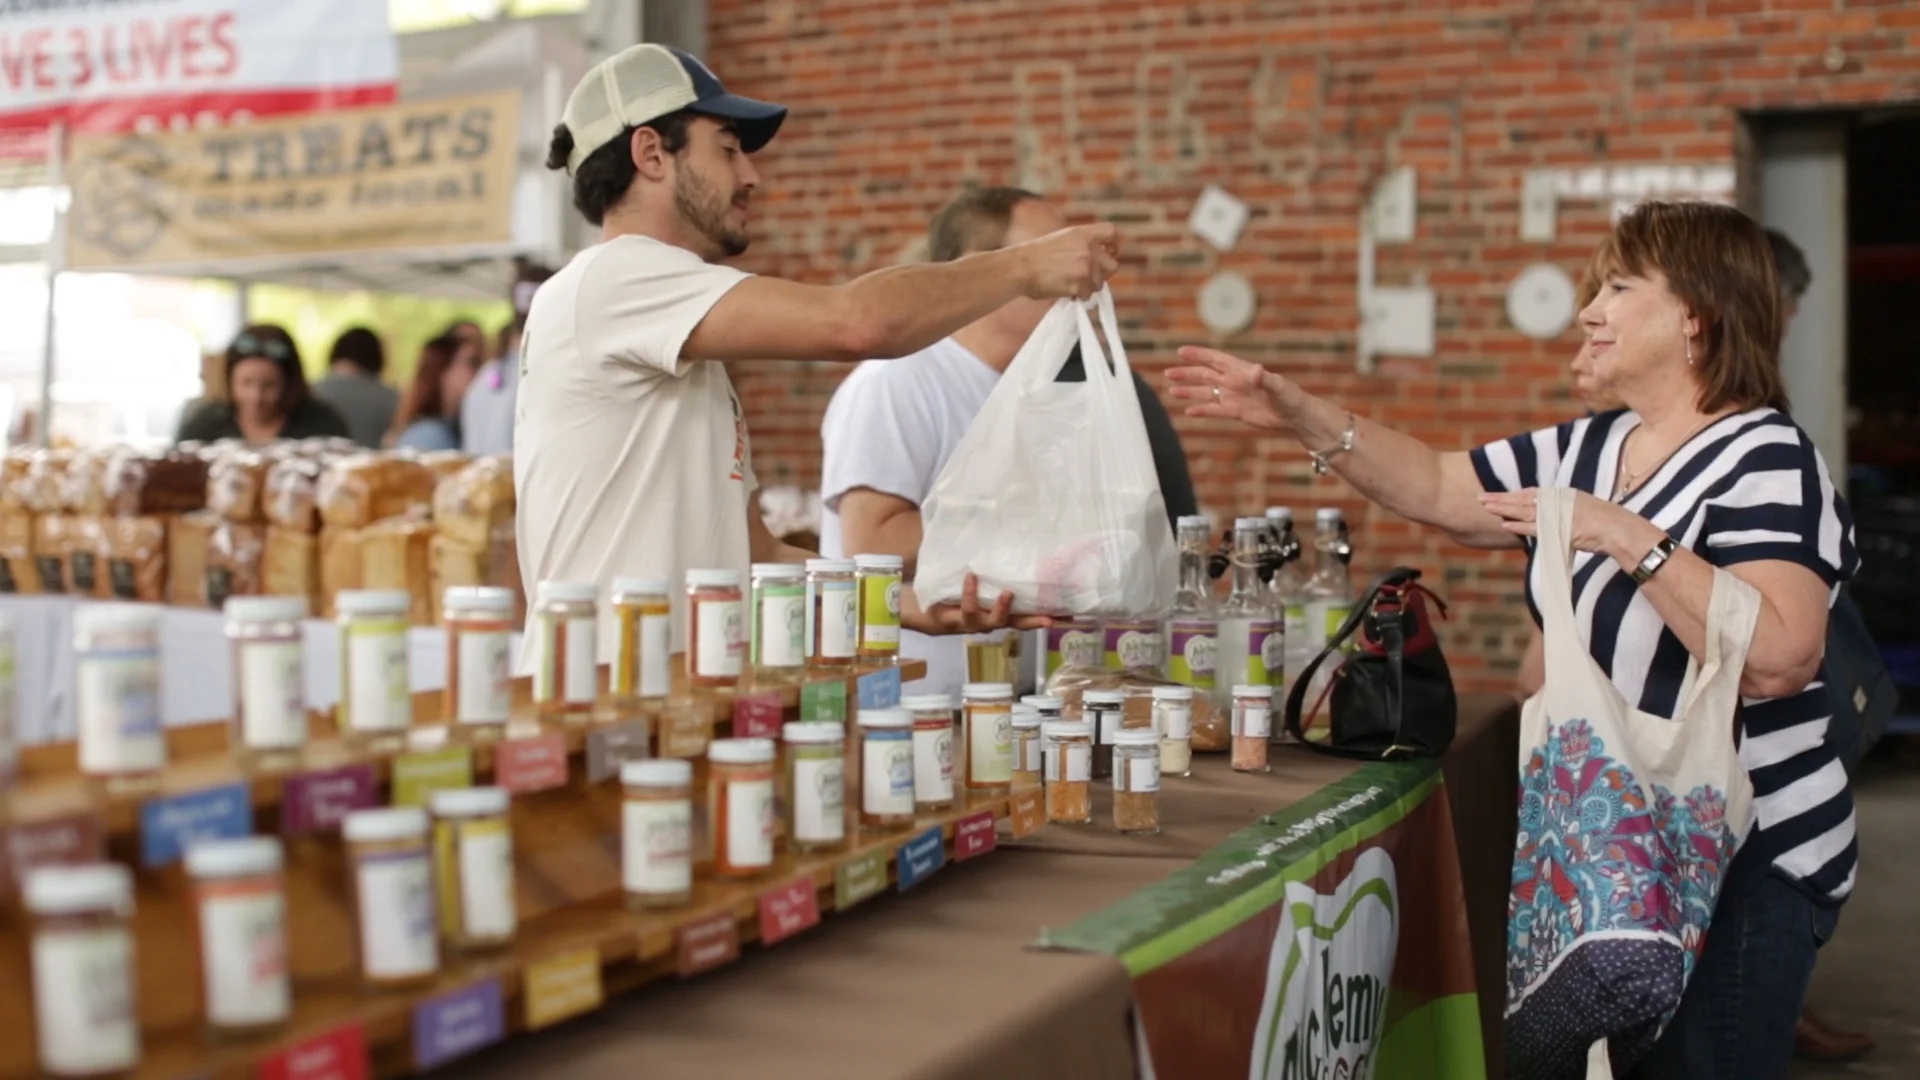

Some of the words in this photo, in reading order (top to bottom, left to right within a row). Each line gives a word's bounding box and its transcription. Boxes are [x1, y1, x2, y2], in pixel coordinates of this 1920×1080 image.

[0, 28, 55, 92] VE
[67, 28, 94, 86] 3
[103, 11, 238, 84] LIVES
[202, 107, 495, 183] TREATS
[350, 172, 486, 209] local
